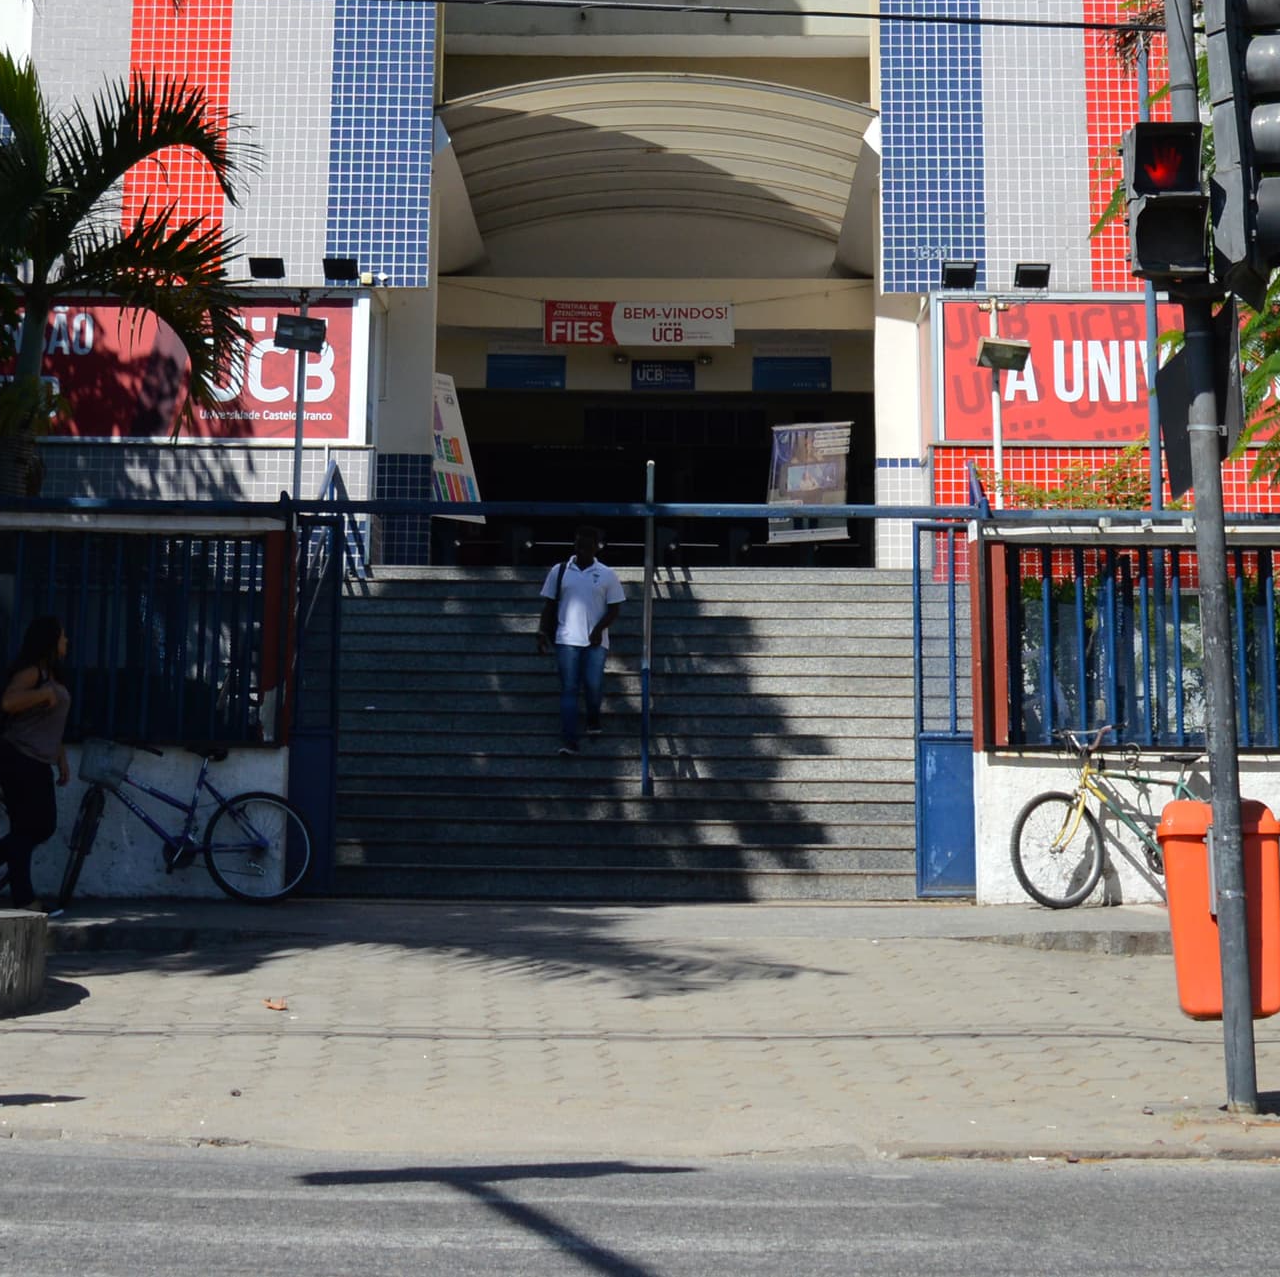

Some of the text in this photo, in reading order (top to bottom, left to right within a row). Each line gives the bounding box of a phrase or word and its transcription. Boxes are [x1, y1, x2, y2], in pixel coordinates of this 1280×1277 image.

[555, 302, 600, 311] CENTRAL DE
[623, 307, 728, 320] BEM-VINDOS!
[551, 321, 604, 343] FIES
[652, 327, 683, 342] UCB
[200, 337, 336, 403] UCB
[637, 368, 663, 381] UCB
